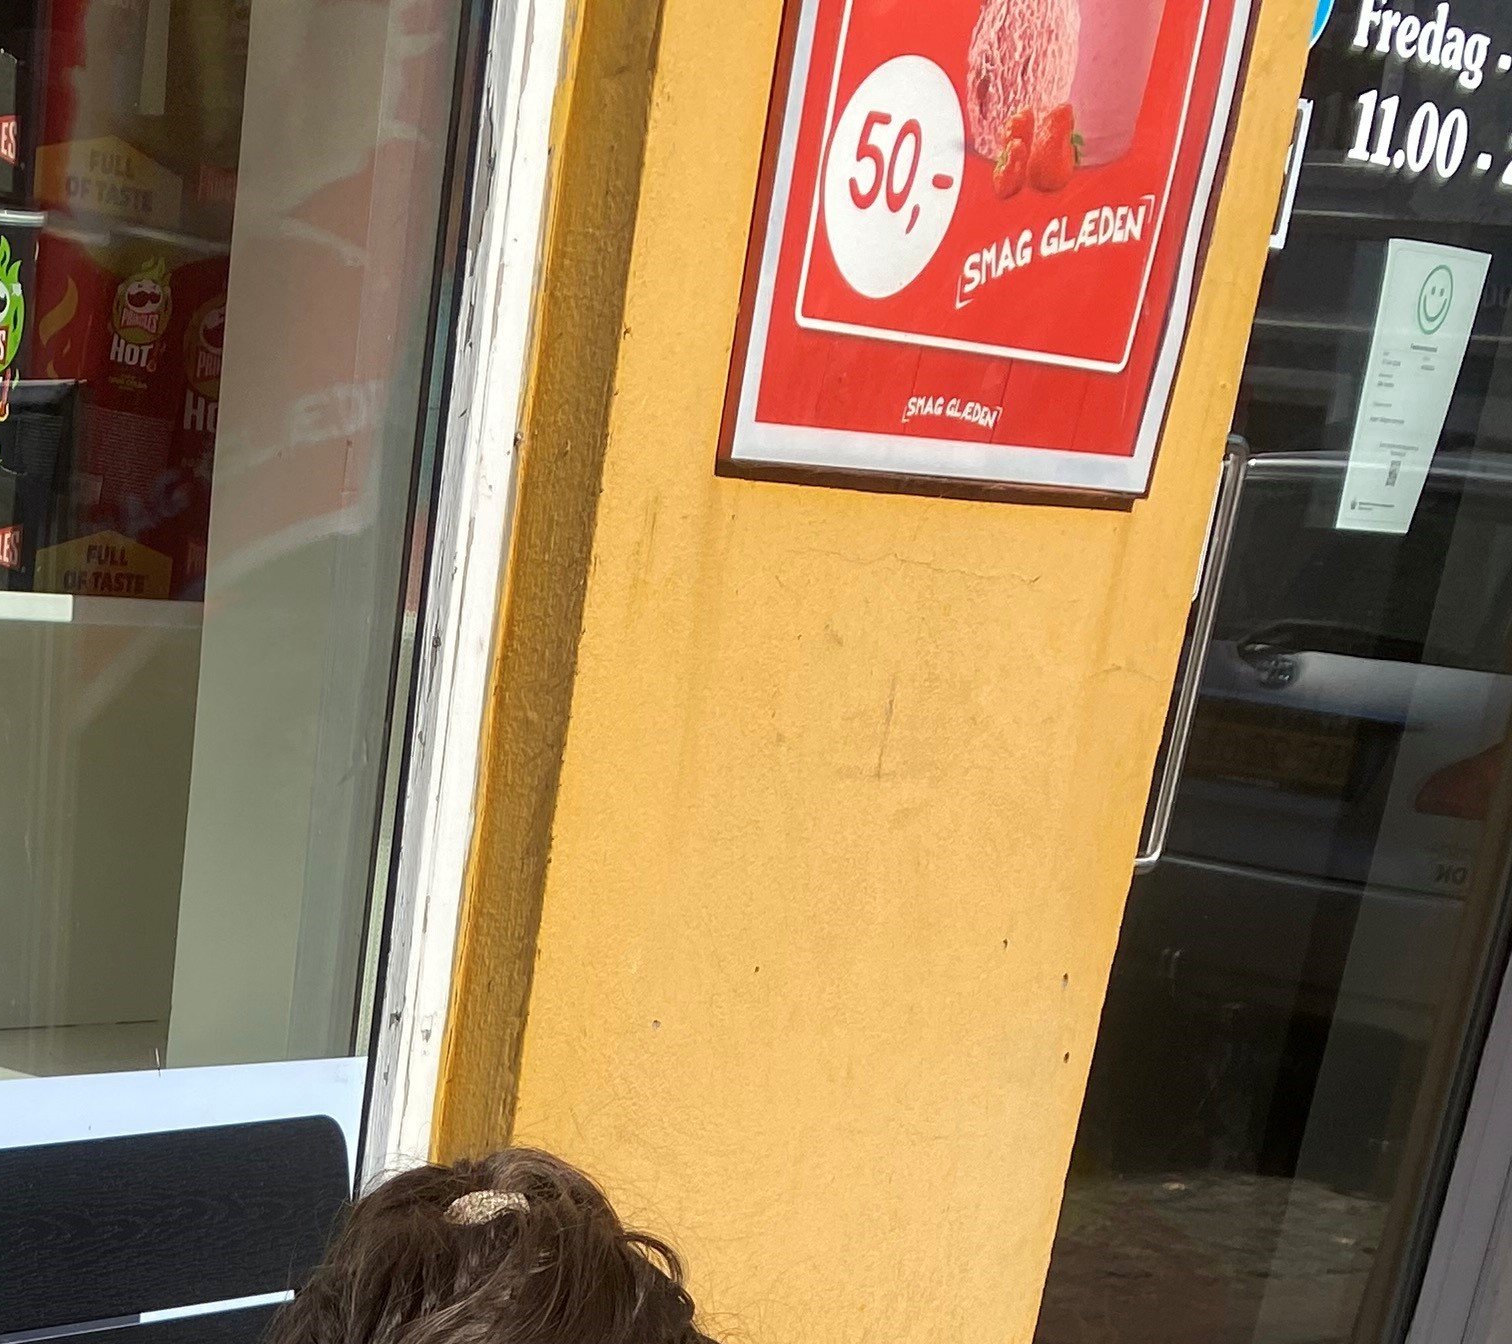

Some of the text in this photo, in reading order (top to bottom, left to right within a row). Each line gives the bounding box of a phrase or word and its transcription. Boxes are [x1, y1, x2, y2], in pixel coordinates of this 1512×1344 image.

[1352, 0, 1492, 90] Fredag
[848, 110, 954, 236] 50,-
[1347, 89, 1469, 179] 11.00
[963, 204, 1147, 294] SMAG GLÆDEN
[906, 396, 999, 430] SMAG GLÆDEN
[86, 545, 129, 566] FULL
